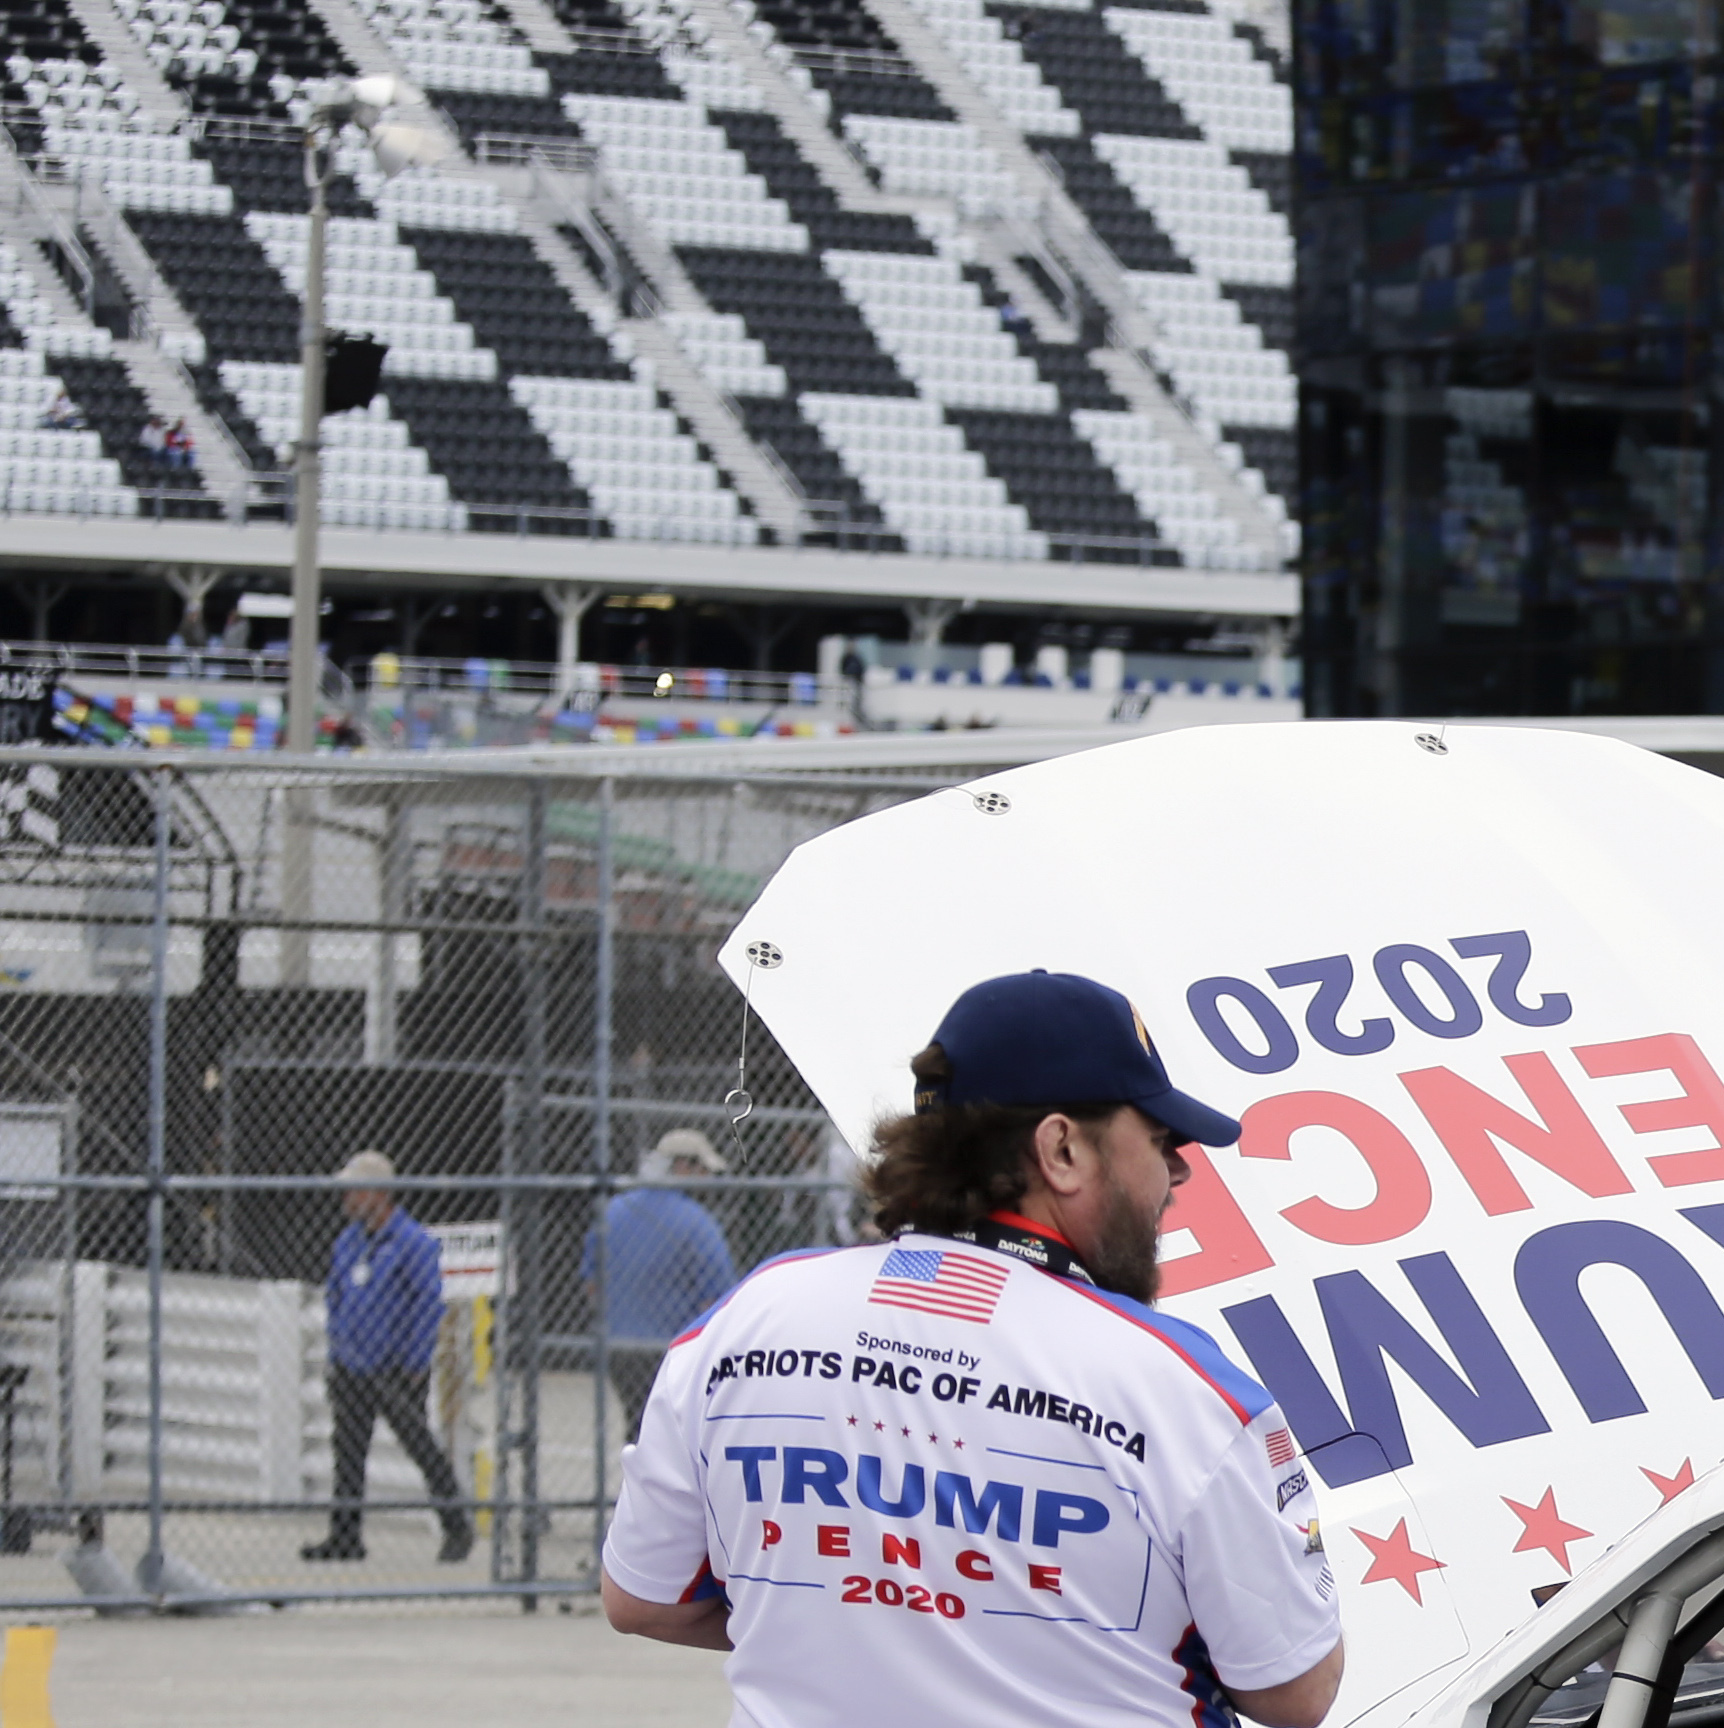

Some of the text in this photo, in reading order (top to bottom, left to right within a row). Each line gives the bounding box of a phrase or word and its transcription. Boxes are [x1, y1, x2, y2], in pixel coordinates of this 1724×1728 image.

[1186, 930, 1573, 1075] 2020
[997, 1239, 1049, 1264] DAYTONA
[855, 1331, 982, 1371] Sponsored by
[852, 1355, 922, 1395] PAC
[931, 1372, 981, 1405] OF
[986, 1385, 1148, 1464] AMERICA
[724, 1446, 1110, 1549] TRUMP
[761, 1519, 1063, 1597] PENCE
[841, 1574, 966, 1620] 2020
